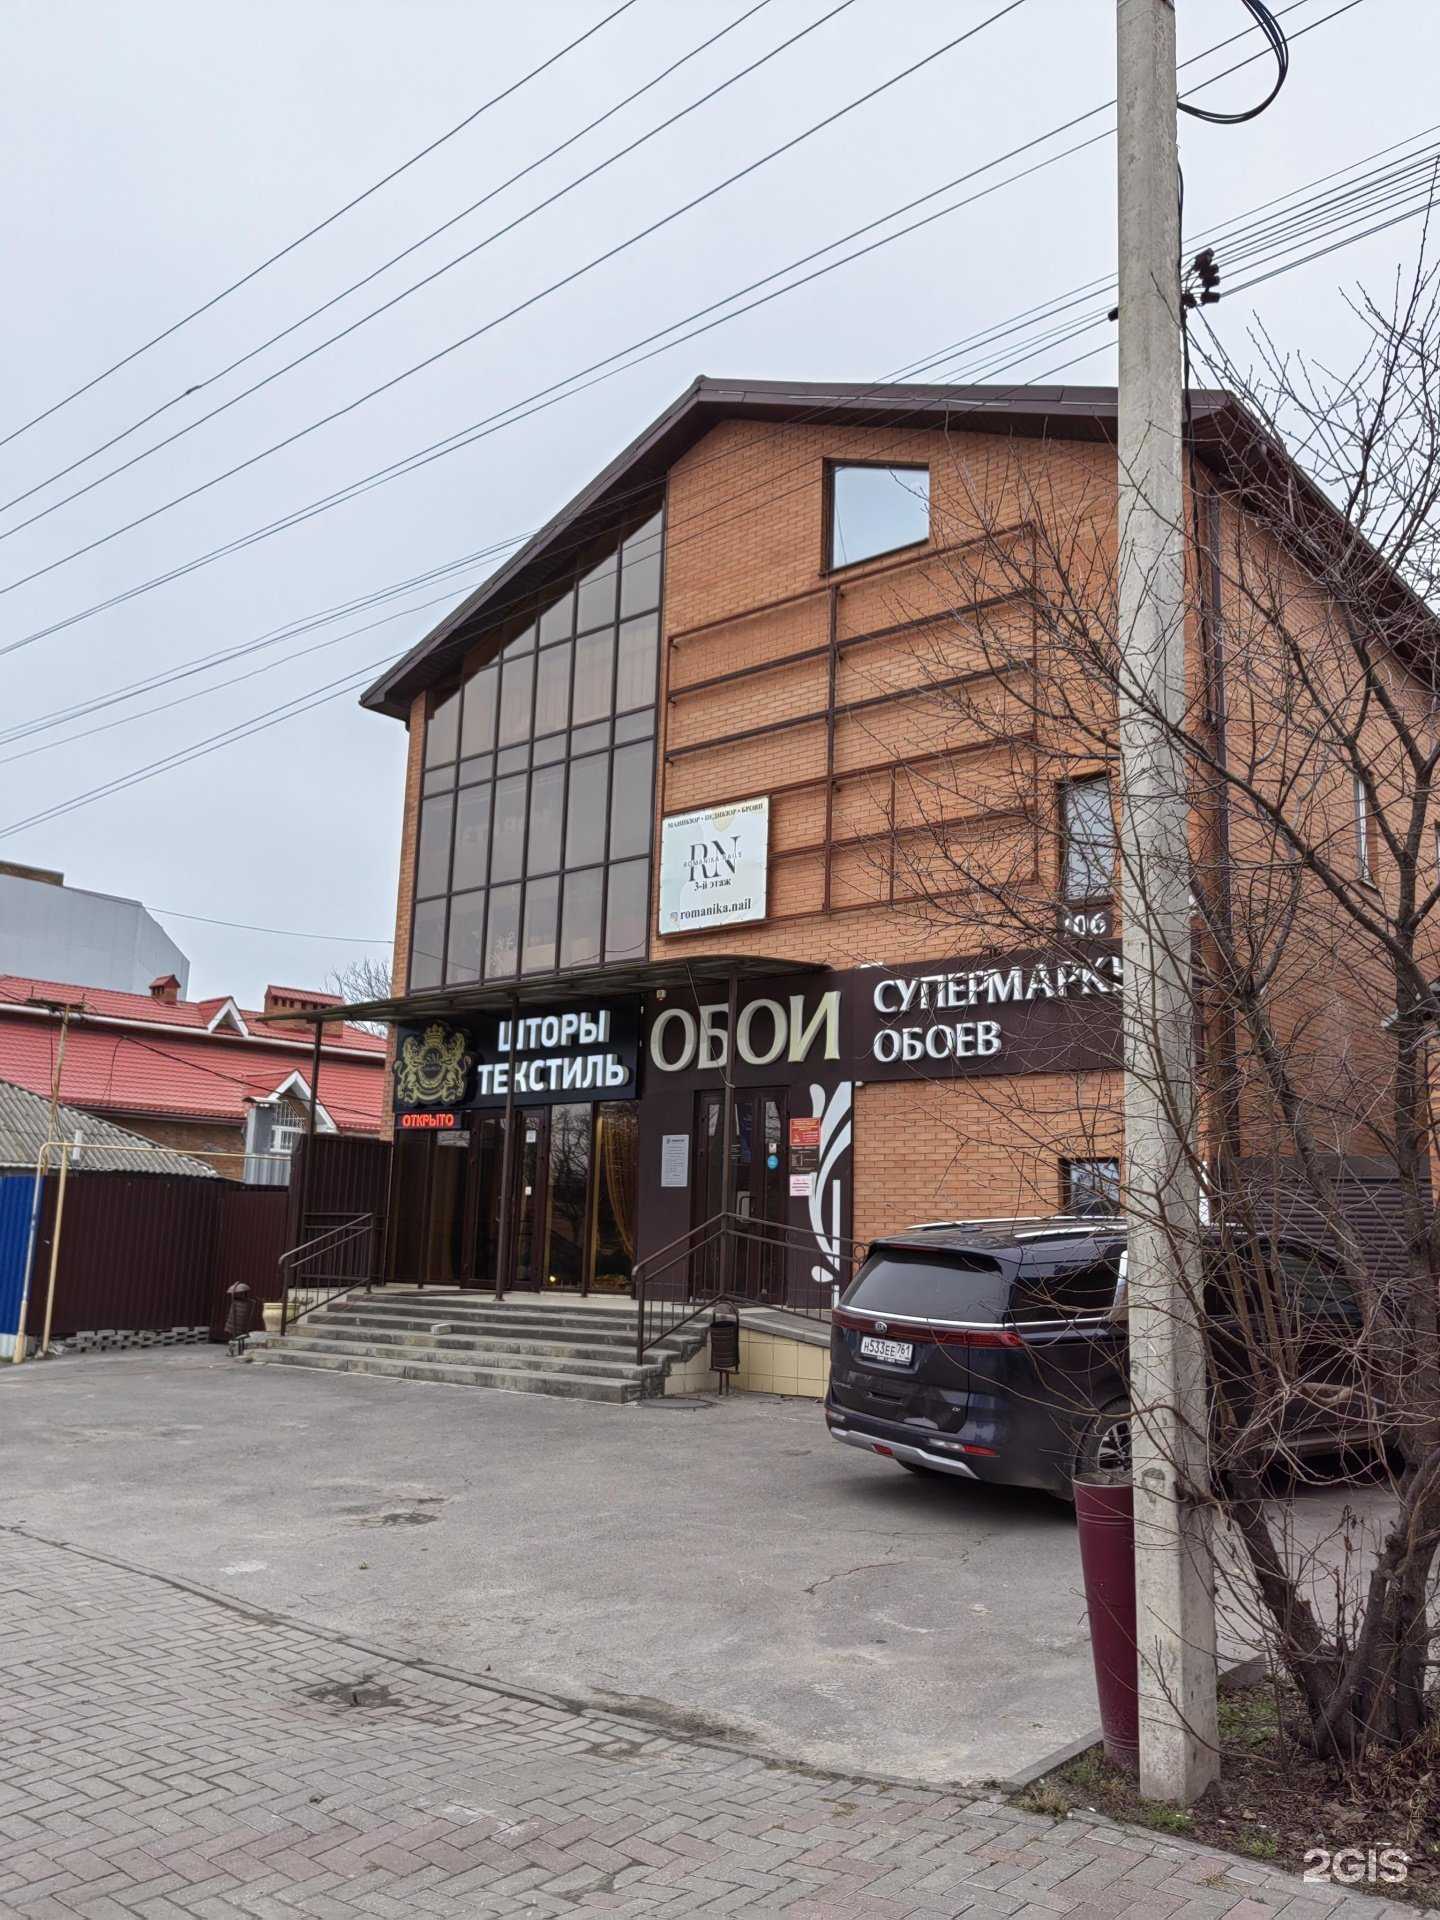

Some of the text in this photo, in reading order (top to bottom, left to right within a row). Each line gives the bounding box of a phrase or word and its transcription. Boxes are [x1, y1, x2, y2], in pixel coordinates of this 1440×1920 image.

[689, 835, 741, 882] RN
[709, 878, 732, 889] этаж
[680, 898, 751, 920] romanika.nail
[498, 1010, 610, 1052] ШТОРЫ
[650, 990, 841, 1072] ОБОИ
[873, 1020, 1002, 1062] ОБОЕВ
[477, 1053, 629, 1096] ТЕКСТИЛЬ
[402, 1113, 455, 1128] ОТКРЫТО
